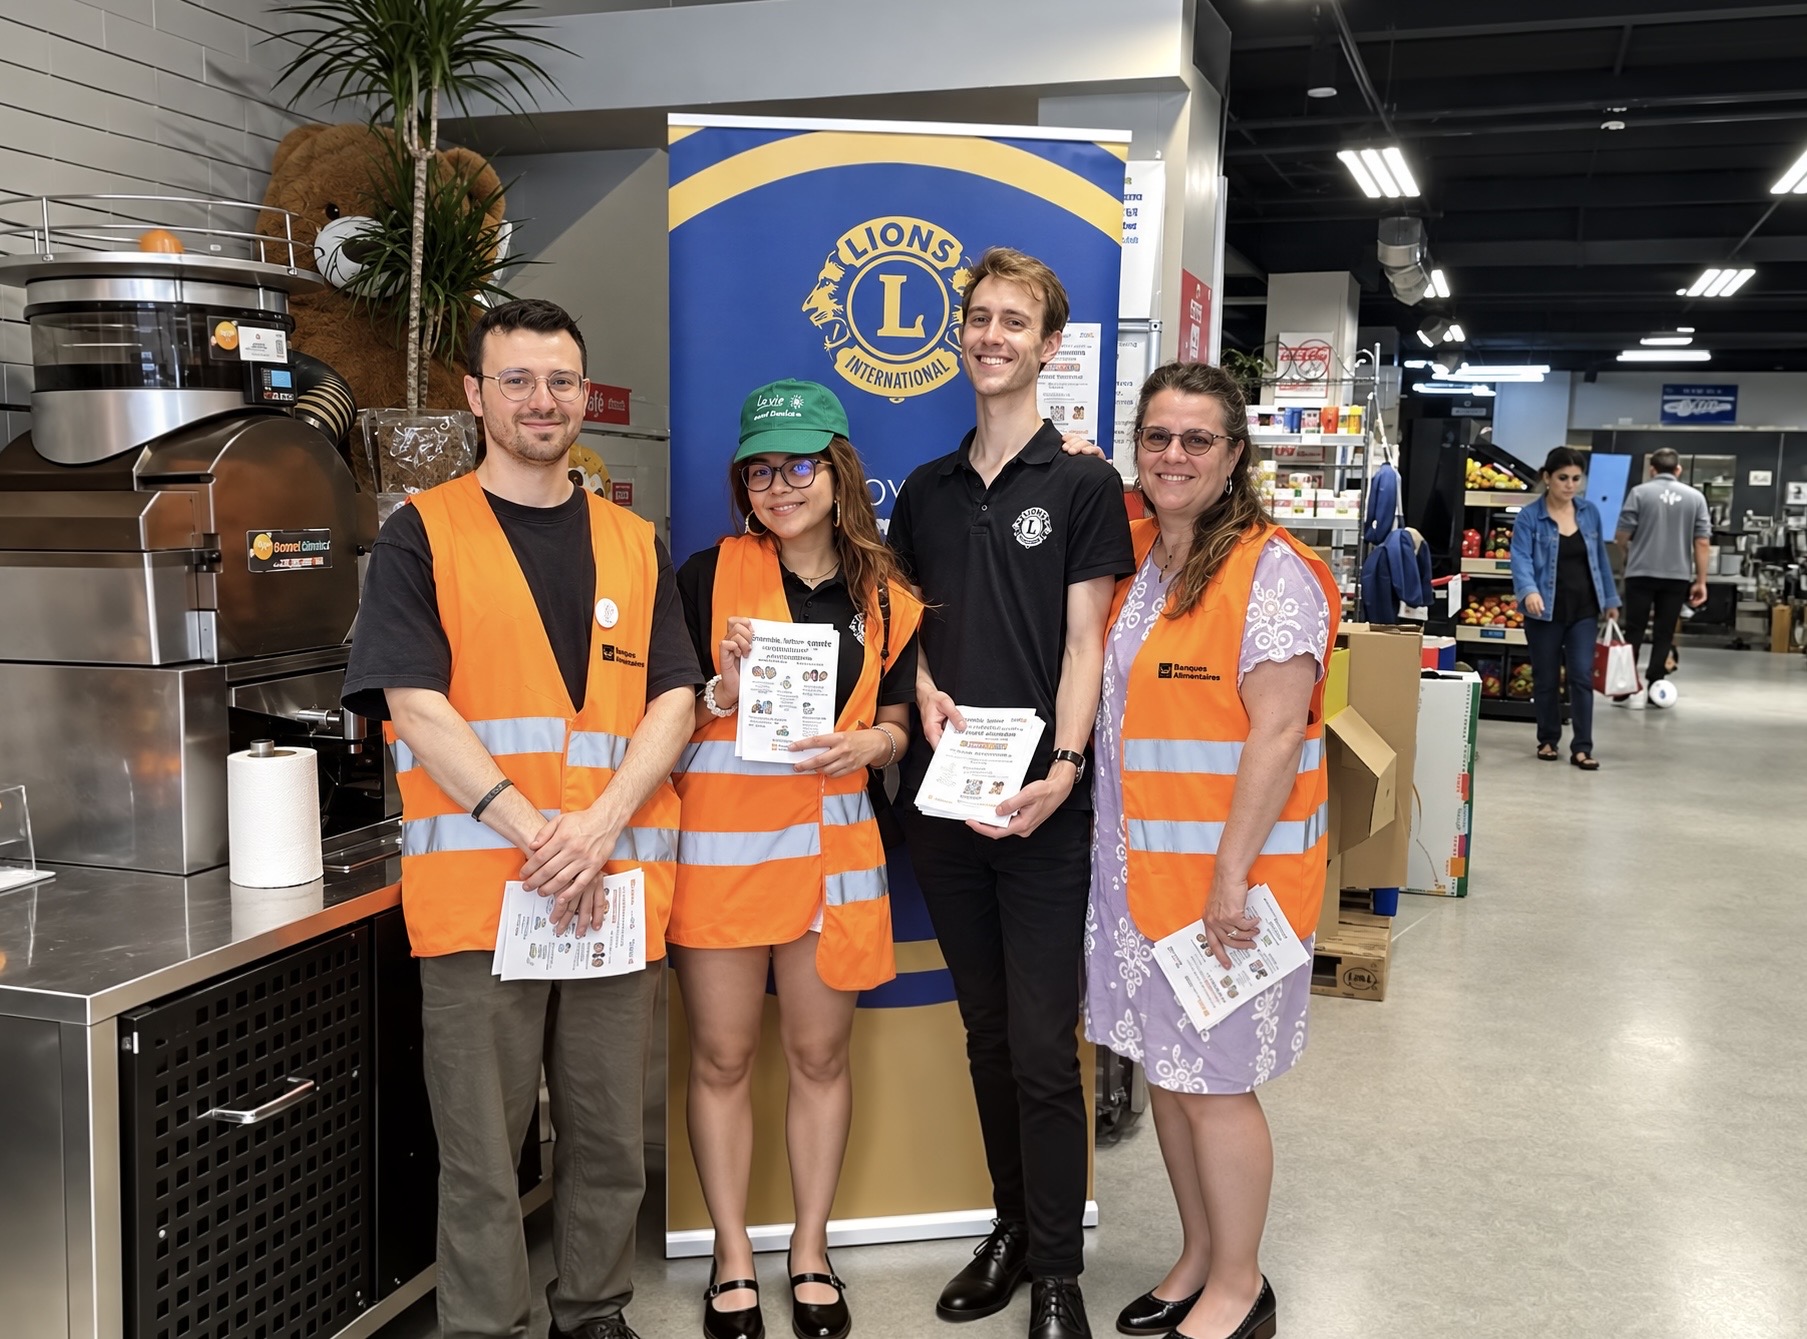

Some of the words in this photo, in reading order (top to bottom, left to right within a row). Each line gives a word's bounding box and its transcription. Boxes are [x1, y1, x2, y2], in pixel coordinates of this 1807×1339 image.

[844, 222, 955, 263] LIONS
[876, 274, 926, 338] L
[844, 355, 951, 389] INTERNATIONAL
[587, 390, 604, 417] afé
[1173, 672, 1220, 680] Alimentaires
[1174, 664, 1207, 672] Banques
